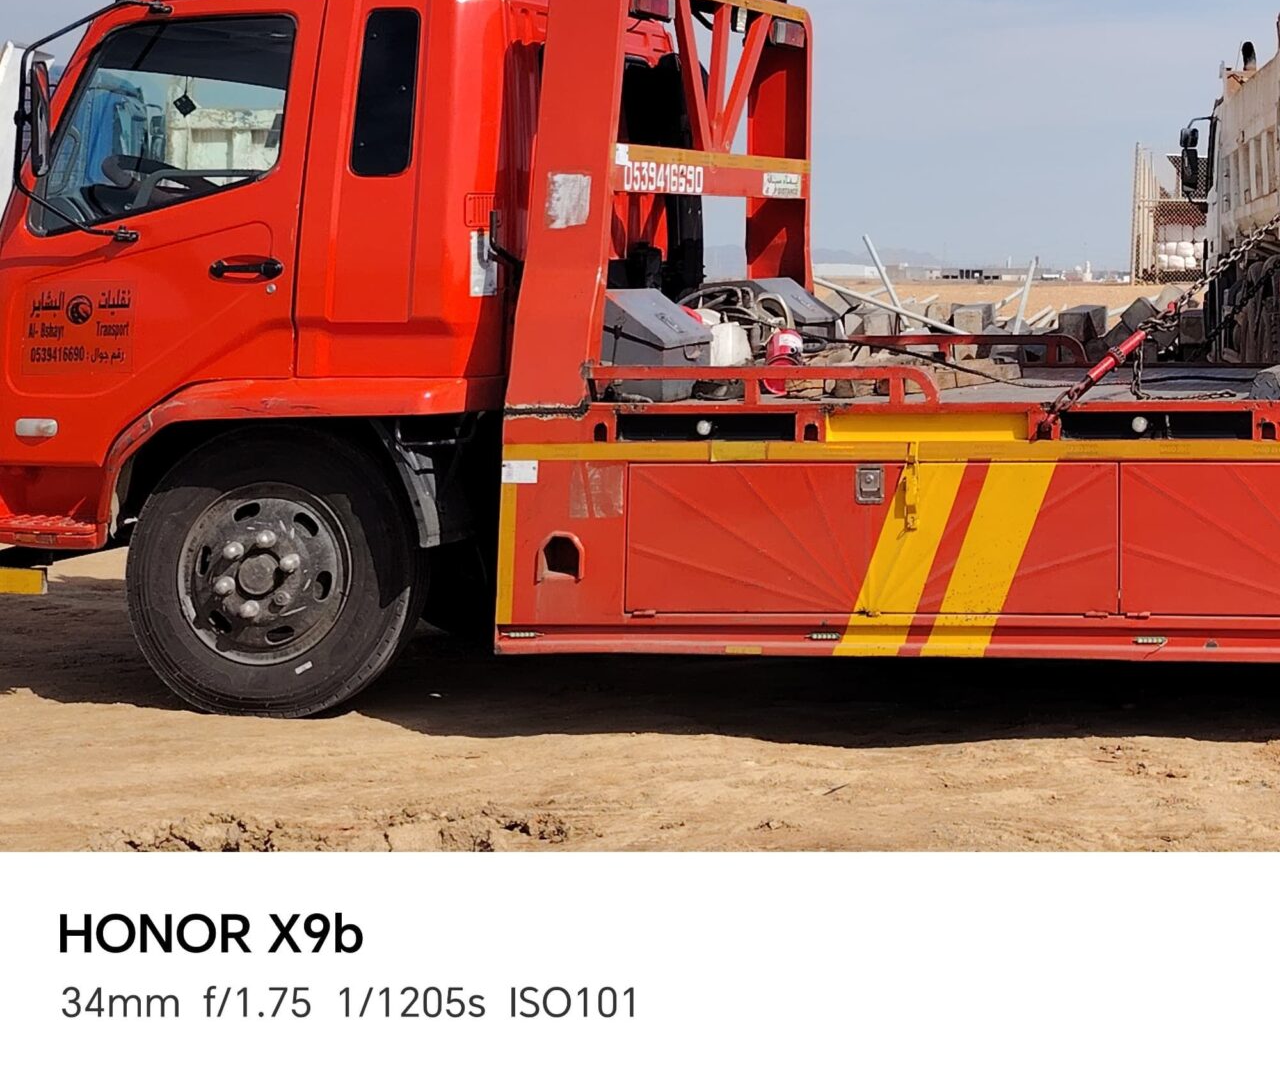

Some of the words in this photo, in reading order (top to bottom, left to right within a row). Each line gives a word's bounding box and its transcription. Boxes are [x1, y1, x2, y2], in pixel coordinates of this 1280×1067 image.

[98, 290, 131, 316] نقليات
[96, 322, 129, 340] Transport
[30, 346, 85, 363] 0539416690
